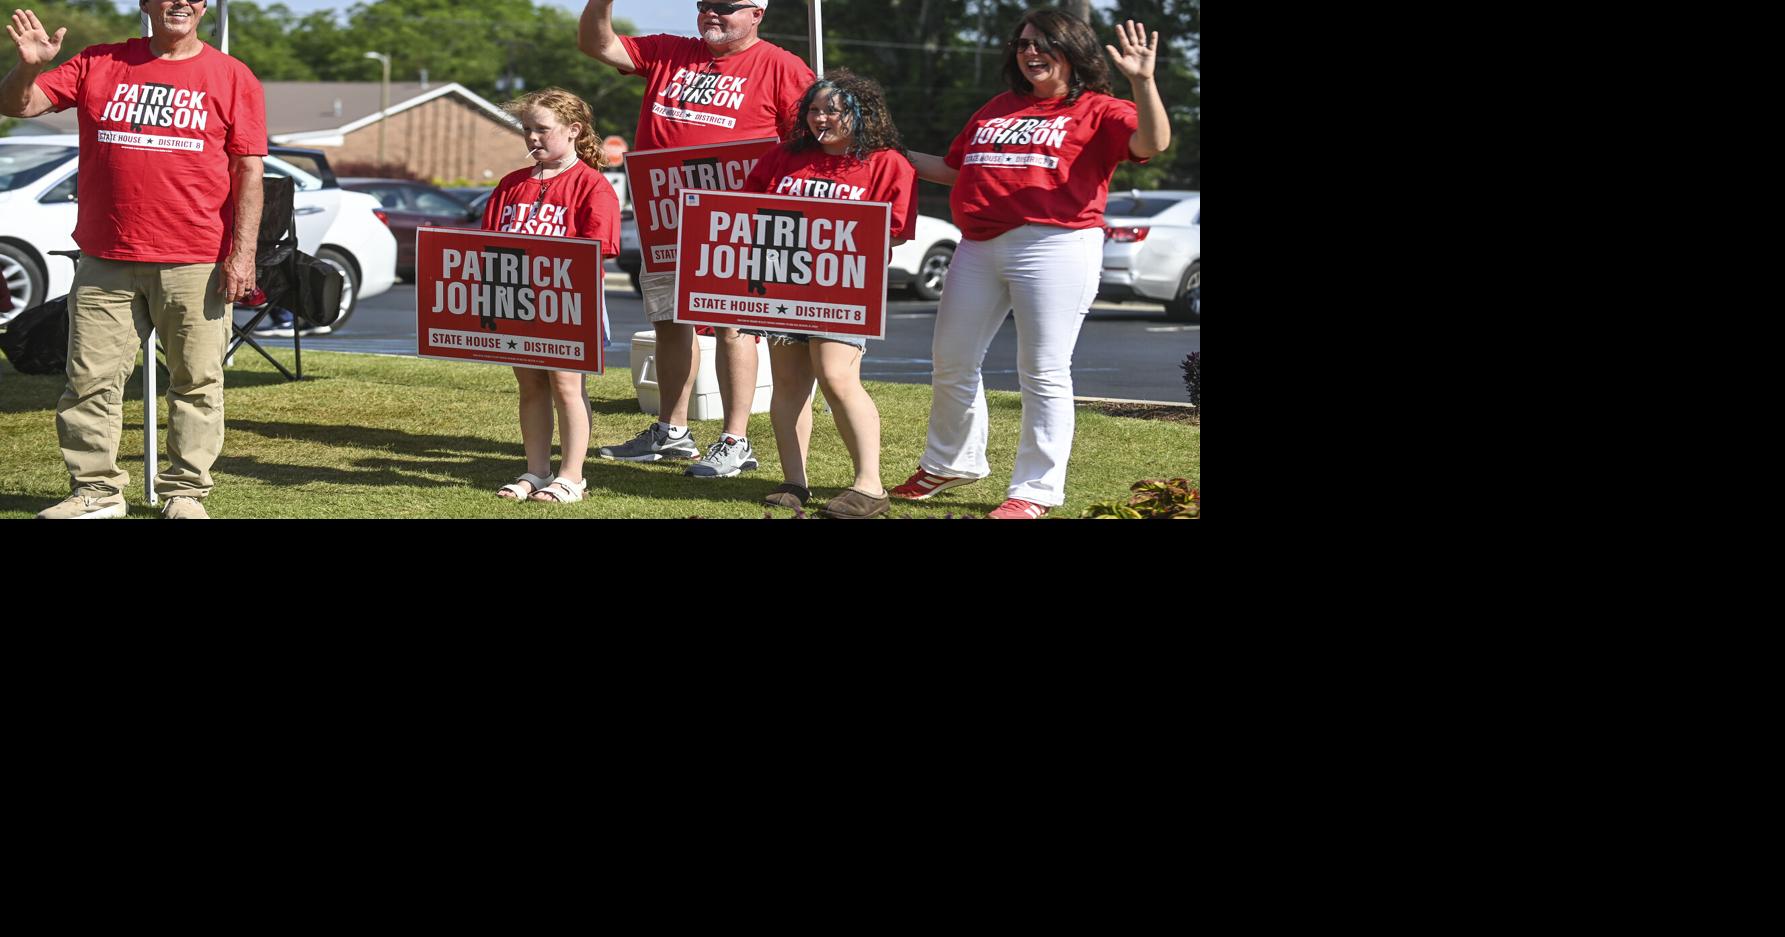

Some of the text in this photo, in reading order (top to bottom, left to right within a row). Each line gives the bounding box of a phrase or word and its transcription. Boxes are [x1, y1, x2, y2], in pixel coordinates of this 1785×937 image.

[672, 67, 747, 93] PATRICK
[112, 83, 206, 110] PATRICK
[658, 81, 745, 110] JOHNSON
[100, 101, 208, 131] JOHNSON
[694, 113, 726, 124] DISTRICT
[99, 132, 117, 141] STATE
[117, 134, 141, 144] HOUSE
[158, 138, 193, 149] DISTRICT
[970, 127, 1068, 149] JOHNSON
[776, 175, 866, 200] PATRICK
[709, 211, 858, 252] PATRICK
[655, 248, 677, 260] STAT
[695, 244, 866, 289] JOHNSON
[443, 248, 573, 290] PATRICK
[432, 280, 582, 326] JOHNSON
[693, 297, 861, 321] STATE HOUSE DISTRICT 8
[432, 332, 581, 357] STATE HOUSE DISTRICT 8
